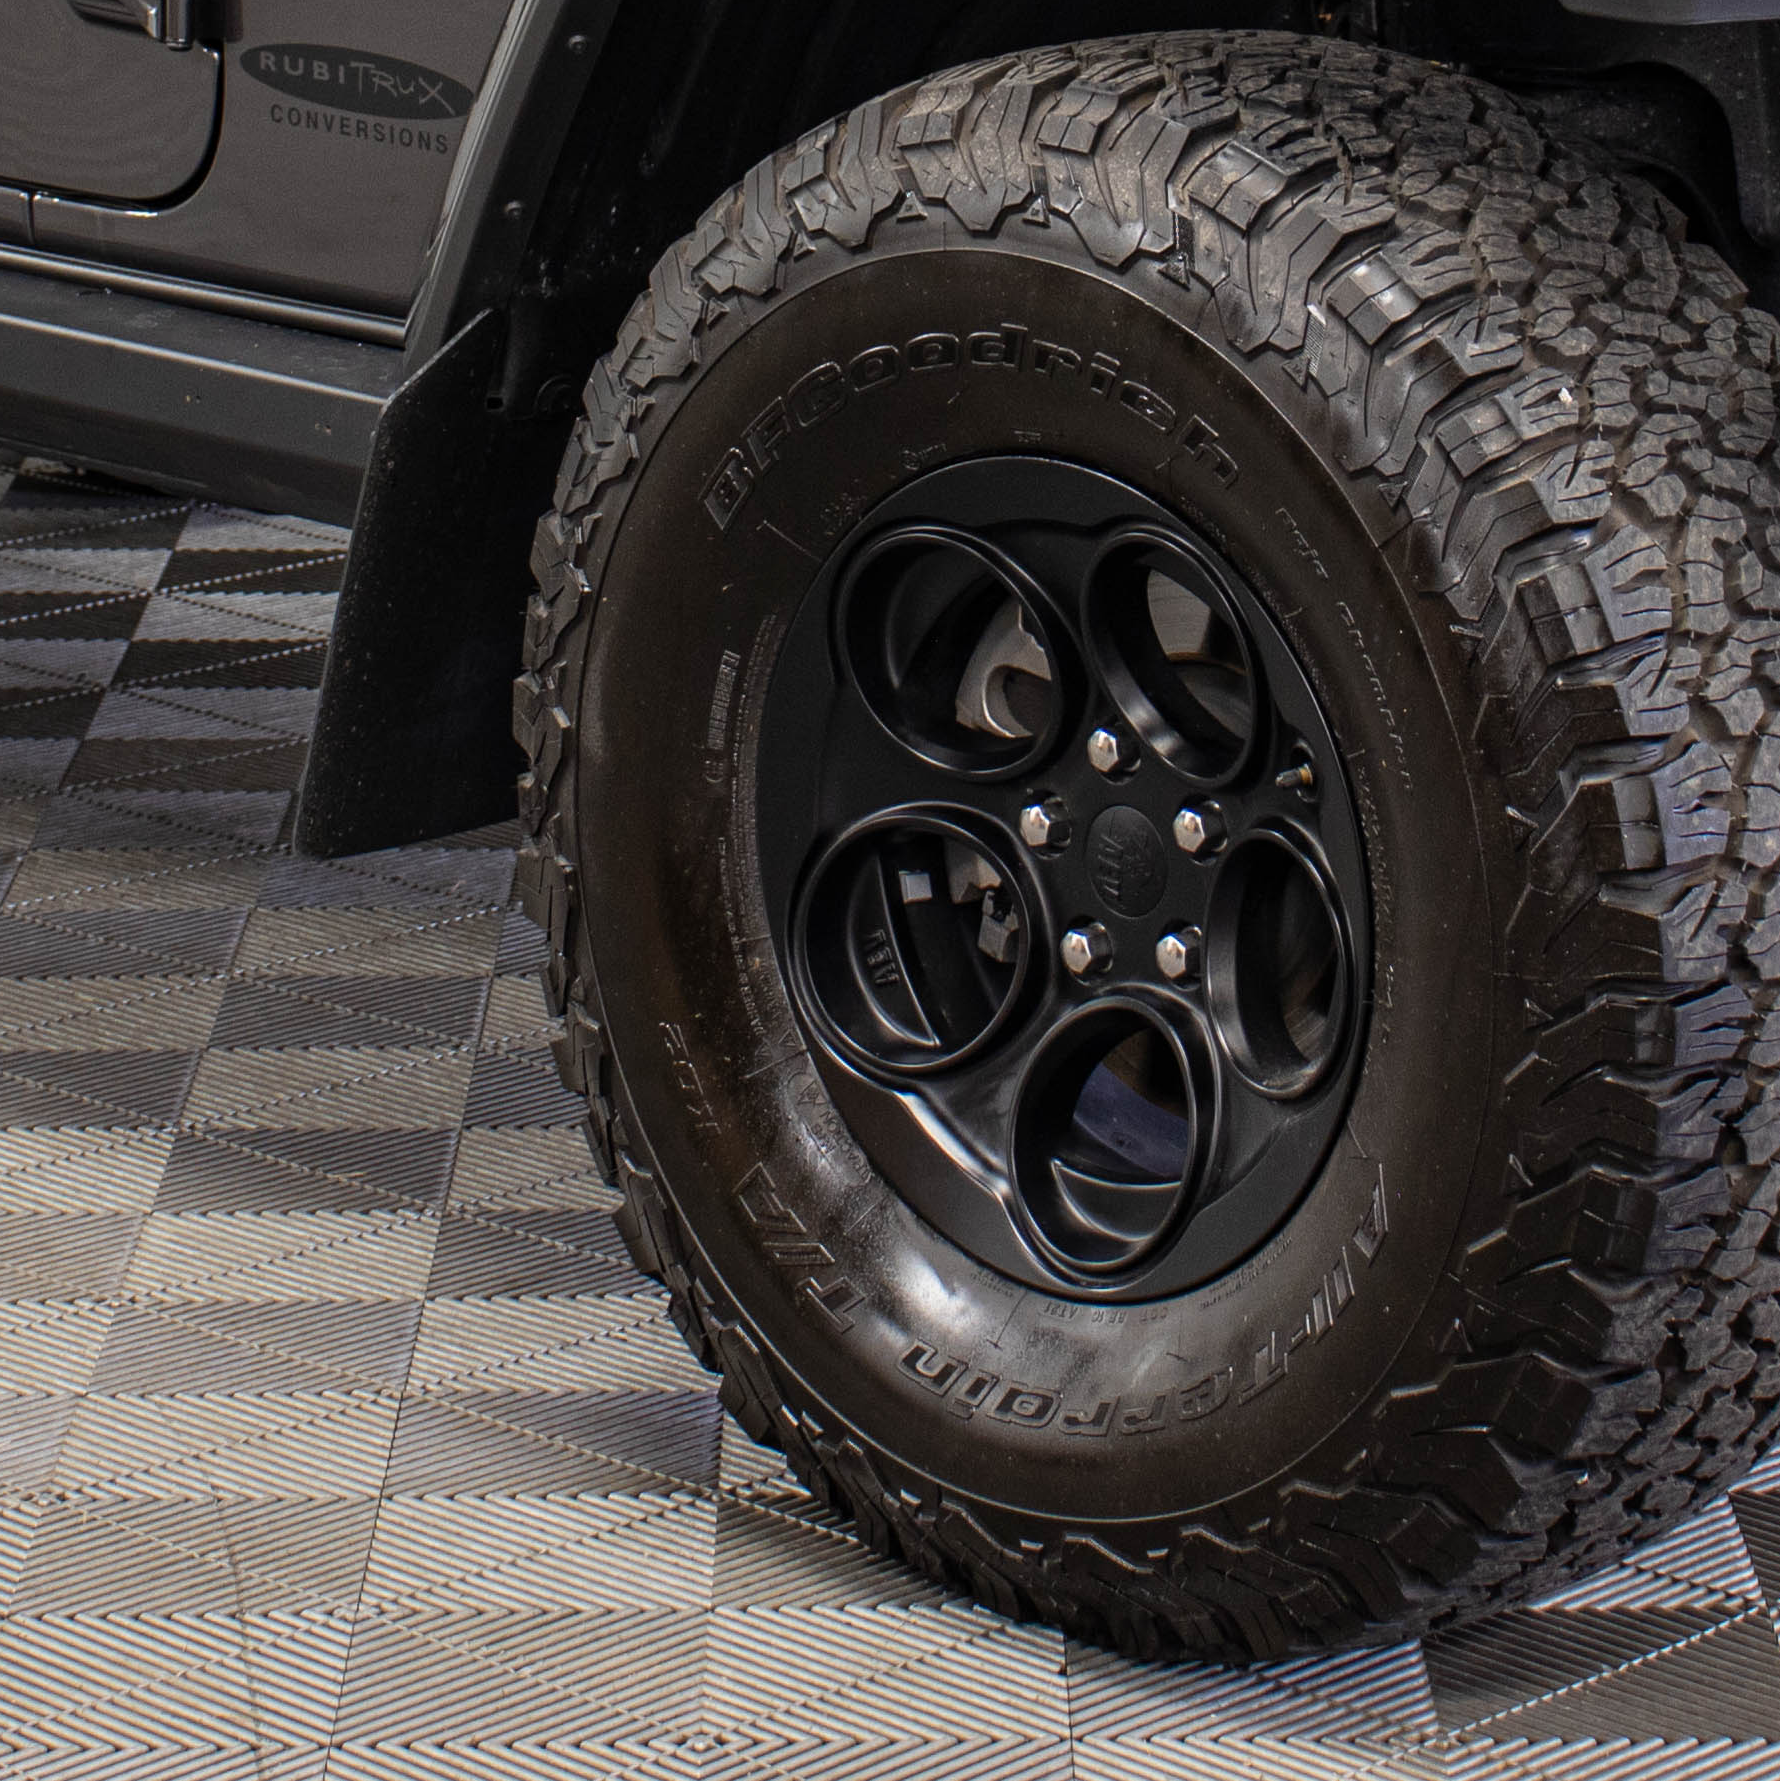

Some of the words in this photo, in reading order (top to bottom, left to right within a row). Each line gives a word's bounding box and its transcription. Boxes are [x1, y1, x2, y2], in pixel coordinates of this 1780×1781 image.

[270, 103, 449, 155] CONVERSIONS
[698, 323, 1239, 530] BFGoodrich
[732, 1161, 873, 1335] T/A
[896, 1162, 1389, 1439] All-Terrain
